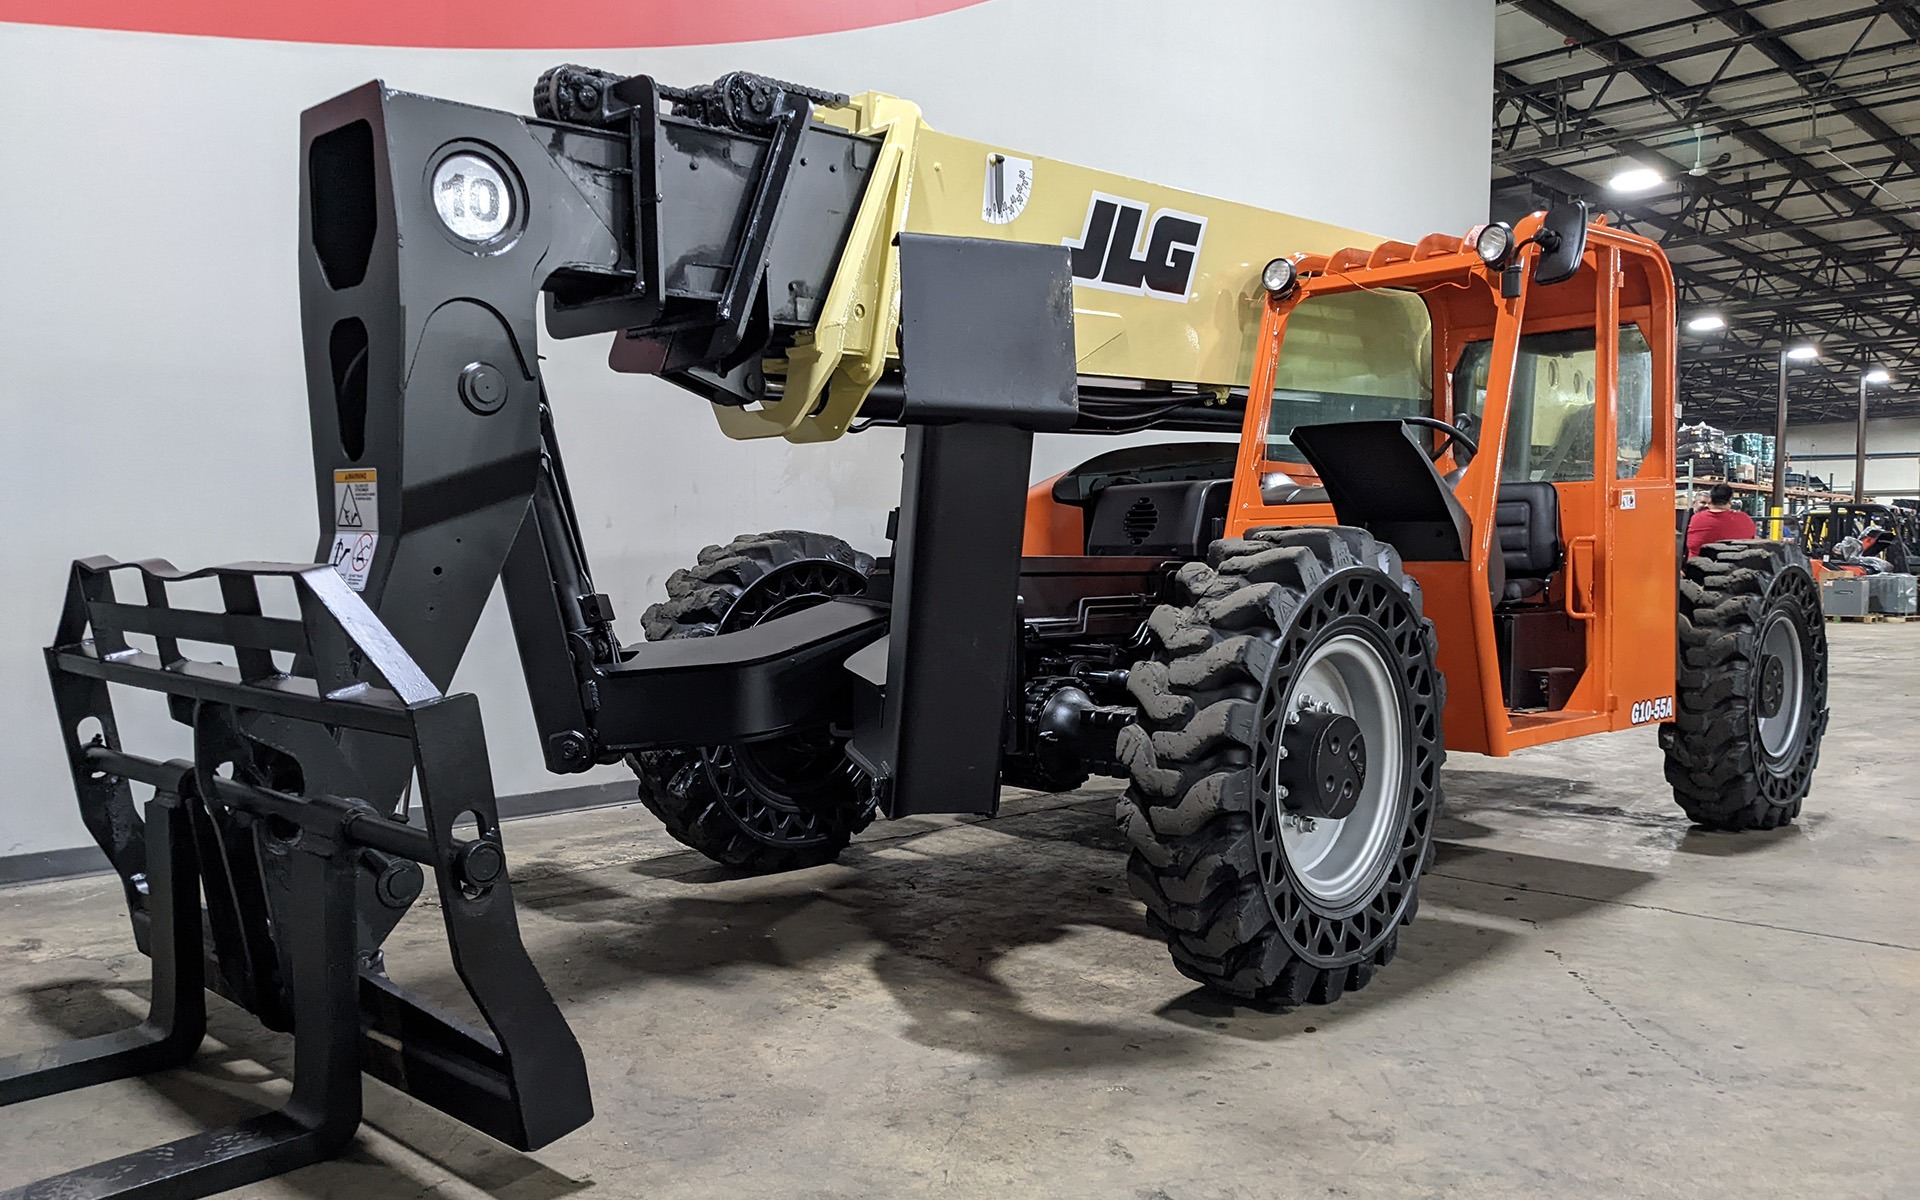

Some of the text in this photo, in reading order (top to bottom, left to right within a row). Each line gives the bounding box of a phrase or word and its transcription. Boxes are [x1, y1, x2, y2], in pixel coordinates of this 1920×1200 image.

[441, 173, 499, 222] 10
[1070, 198, 1203, 296] JLG
[1631, 695, 1673, 725] G10-55A
